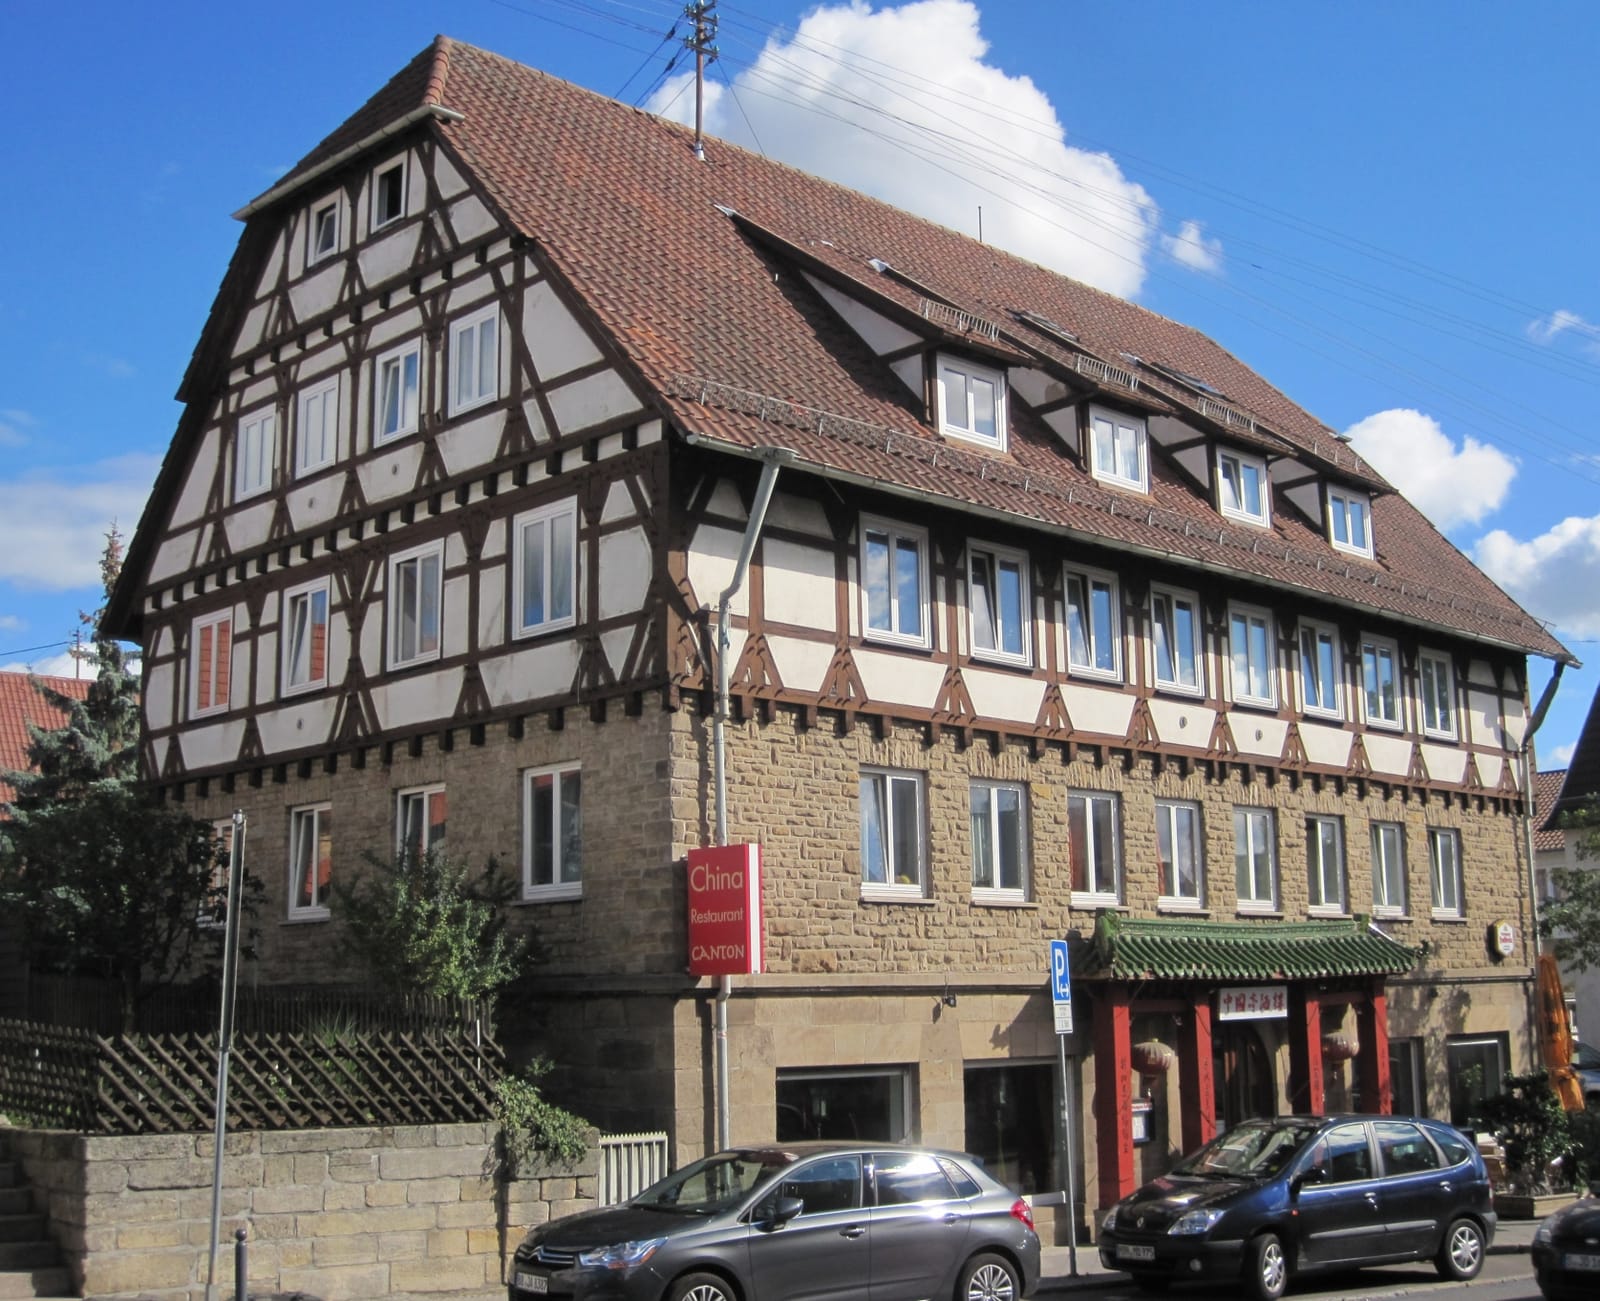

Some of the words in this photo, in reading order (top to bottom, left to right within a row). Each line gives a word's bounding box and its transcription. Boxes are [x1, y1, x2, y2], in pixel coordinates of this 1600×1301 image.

[690, 862, 743, 893] China
[690, 906, 744, 924] Restaurant
[691, 944, 745, 961] CANTON
[1054, 948, 1065, 994] P
